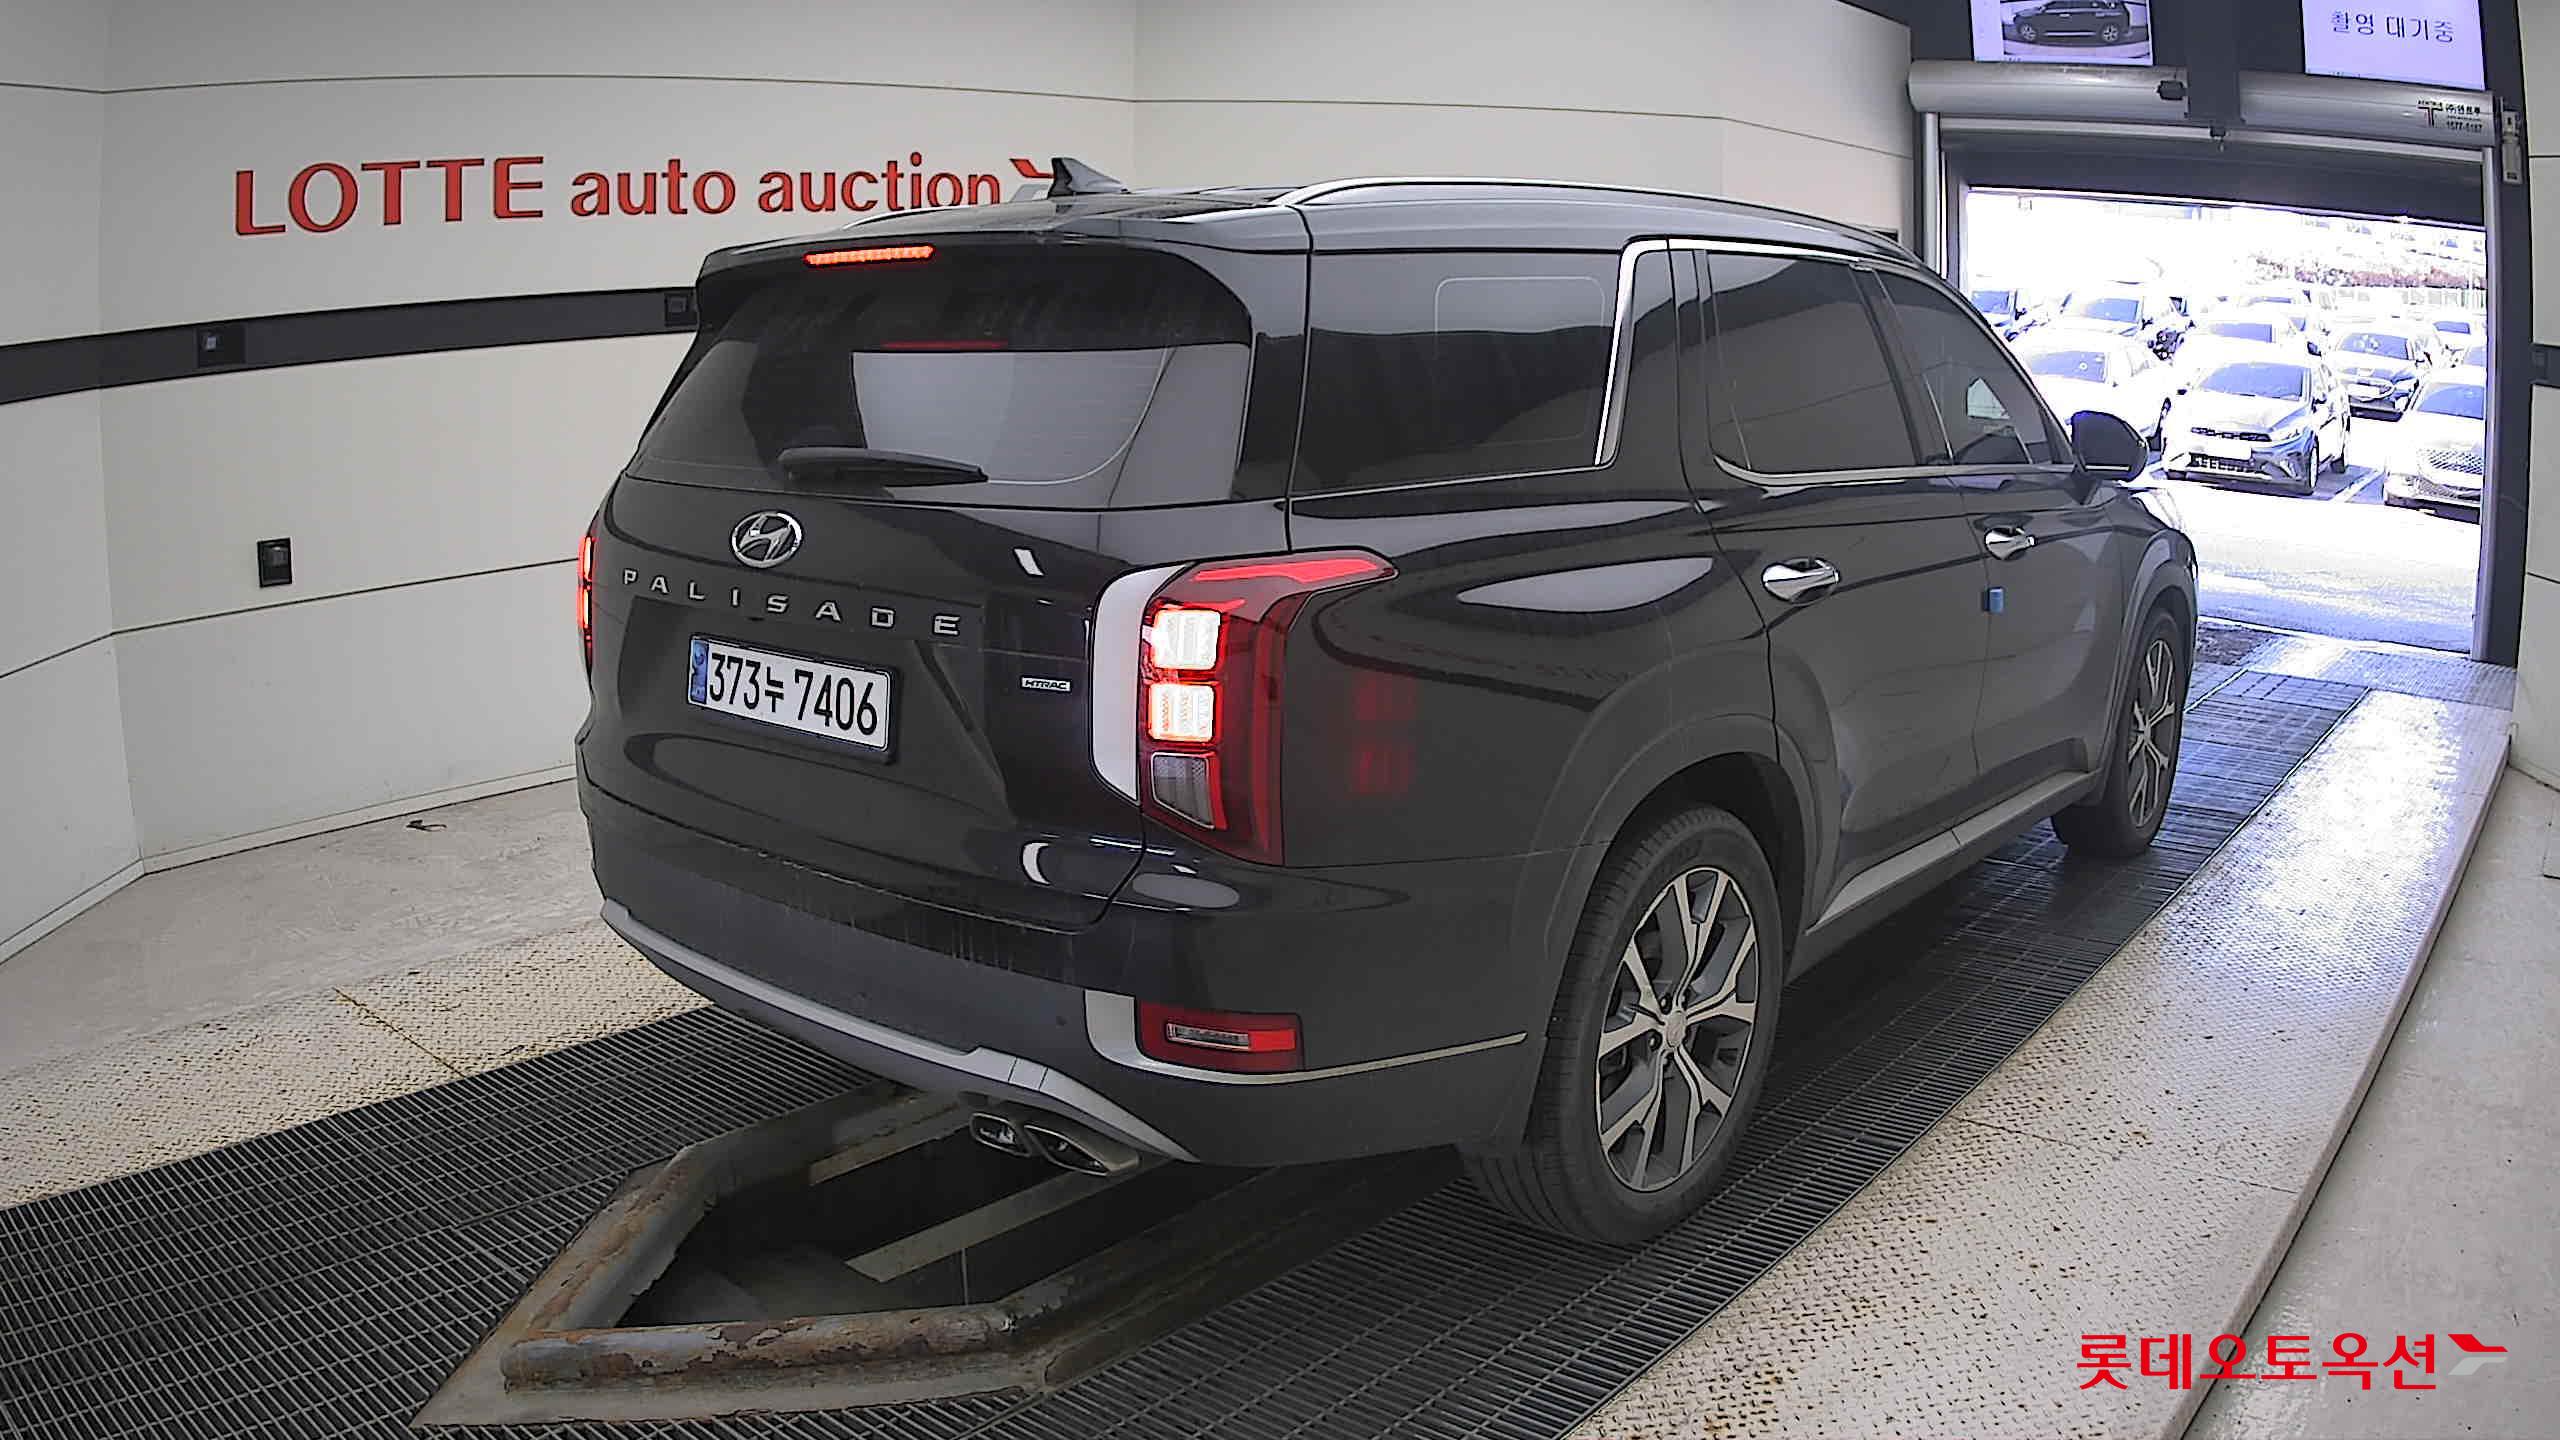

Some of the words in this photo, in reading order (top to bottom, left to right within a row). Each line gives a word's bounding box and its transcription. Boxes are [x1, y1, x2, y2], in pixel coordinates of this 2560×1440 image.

[2331, 10, 2374, 35] 촬영
[2386, 16, 2454, 43] 대기중
[235, 156, 544, 236] LOTTE
[570, 158, 737, 217] auto
[757, 151, 1001, 212] auction
[623, 569, 961, 635] PALISADE
[709, 652, 784, 713] 373누
[794, 668, 878, 735] 7406
[1024, 679, 1068, 690] HTRAC
